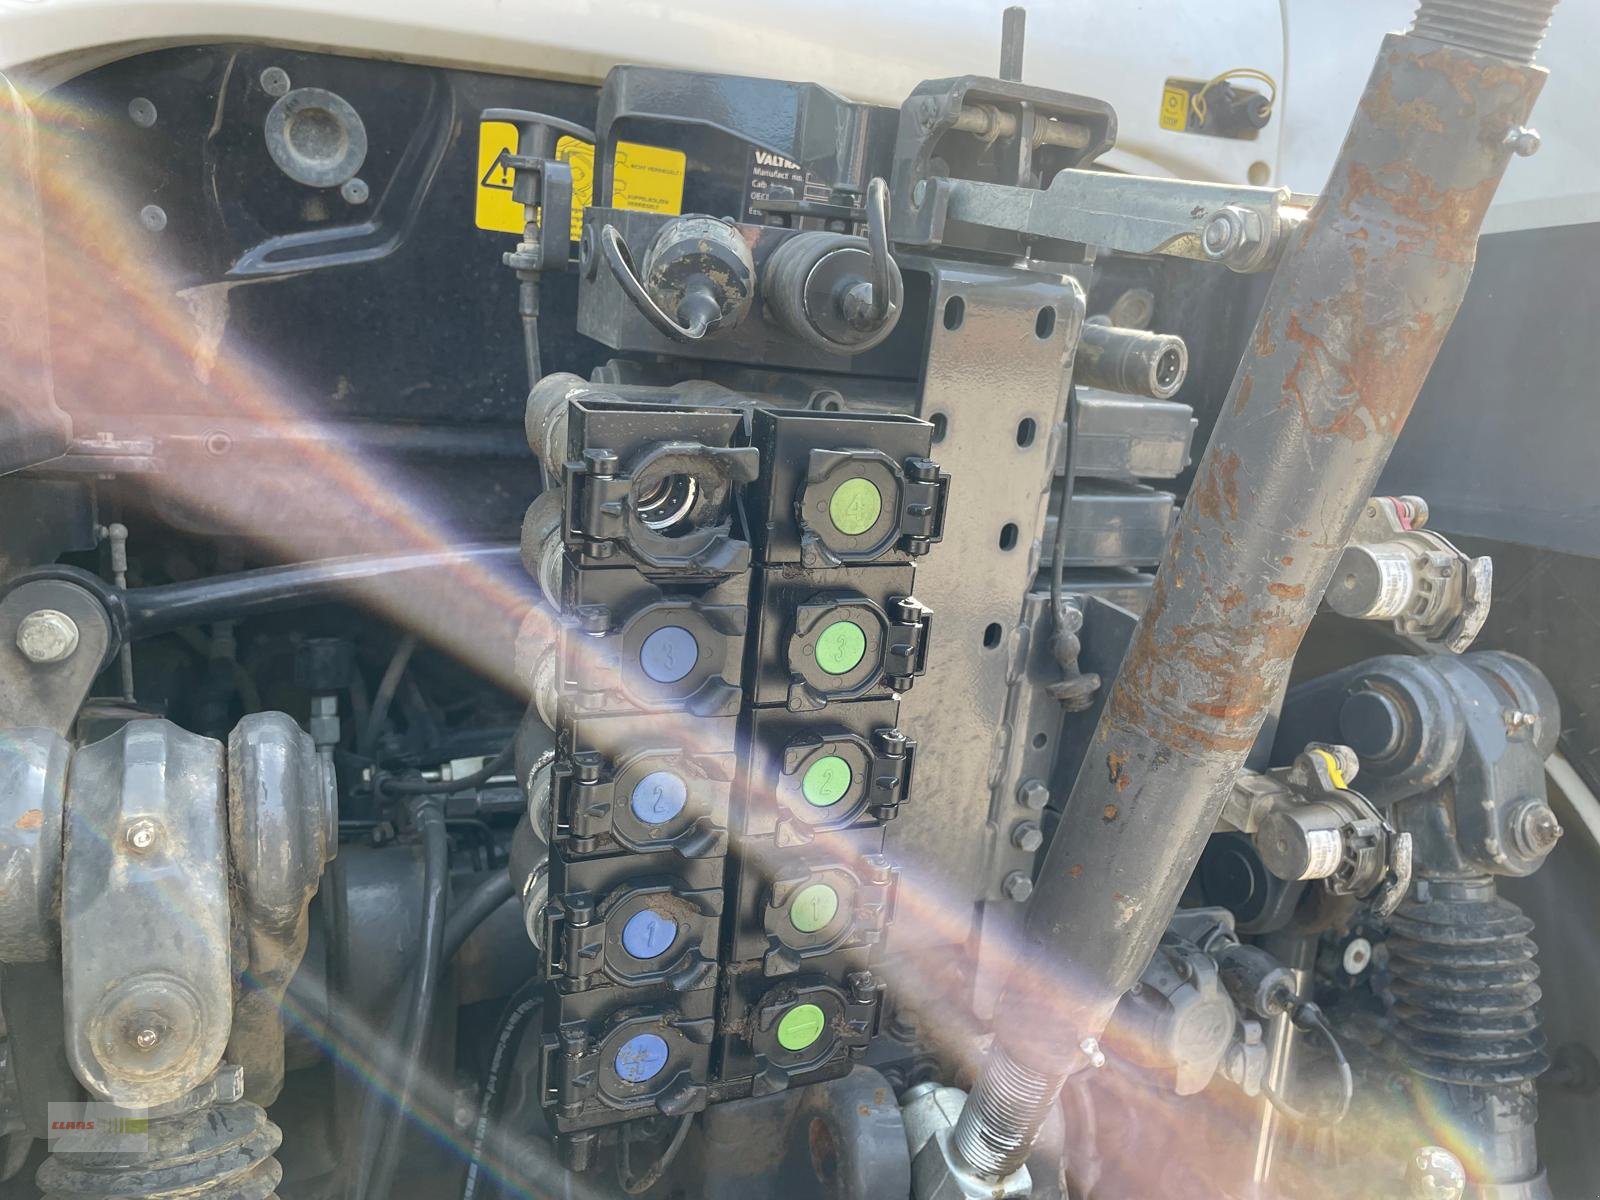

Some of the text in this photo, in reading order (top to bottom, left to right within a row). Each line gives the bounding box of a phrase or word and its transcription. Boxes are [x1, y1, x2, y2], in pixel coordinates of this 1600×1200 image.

[847, 493, 864, 522] 4
[662, 640, 675, 671] 3
[834, 634, 846, 663] 3
[818, 767, 834, 796] 2
[652, 785, 665, 814] 2
[810, 895, 819, 922] 1
[646, 920, 658, 948] 1
